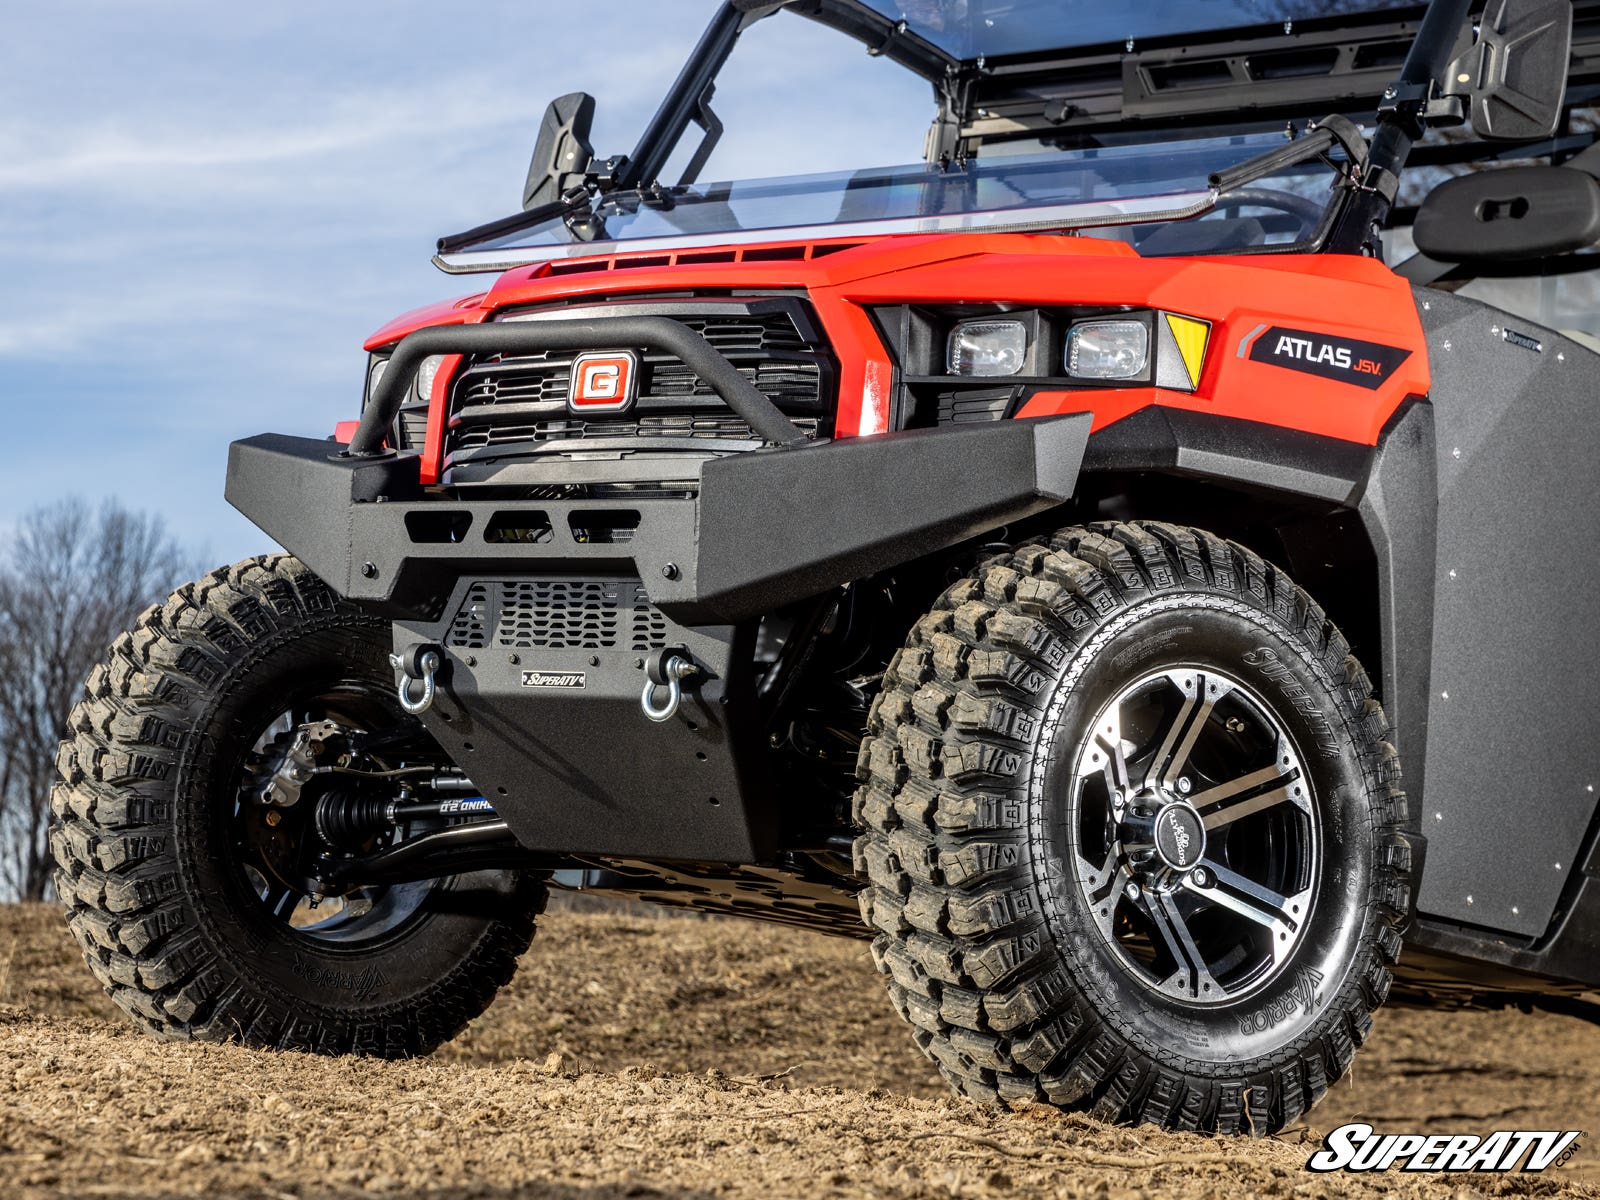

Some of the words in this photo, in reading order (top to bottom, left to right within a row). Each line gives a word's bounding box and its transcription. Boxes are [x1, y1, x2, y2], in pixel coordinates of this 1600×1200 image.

[1274, 336, 1351, 369] ATLAS
[583, 365, 619, 398] G
[526, 673, 580, 686] SUPERATV
[292, 952, 391, 1000] WARRIOR
[1234, 964, 1324, 1036] WARRIOR
